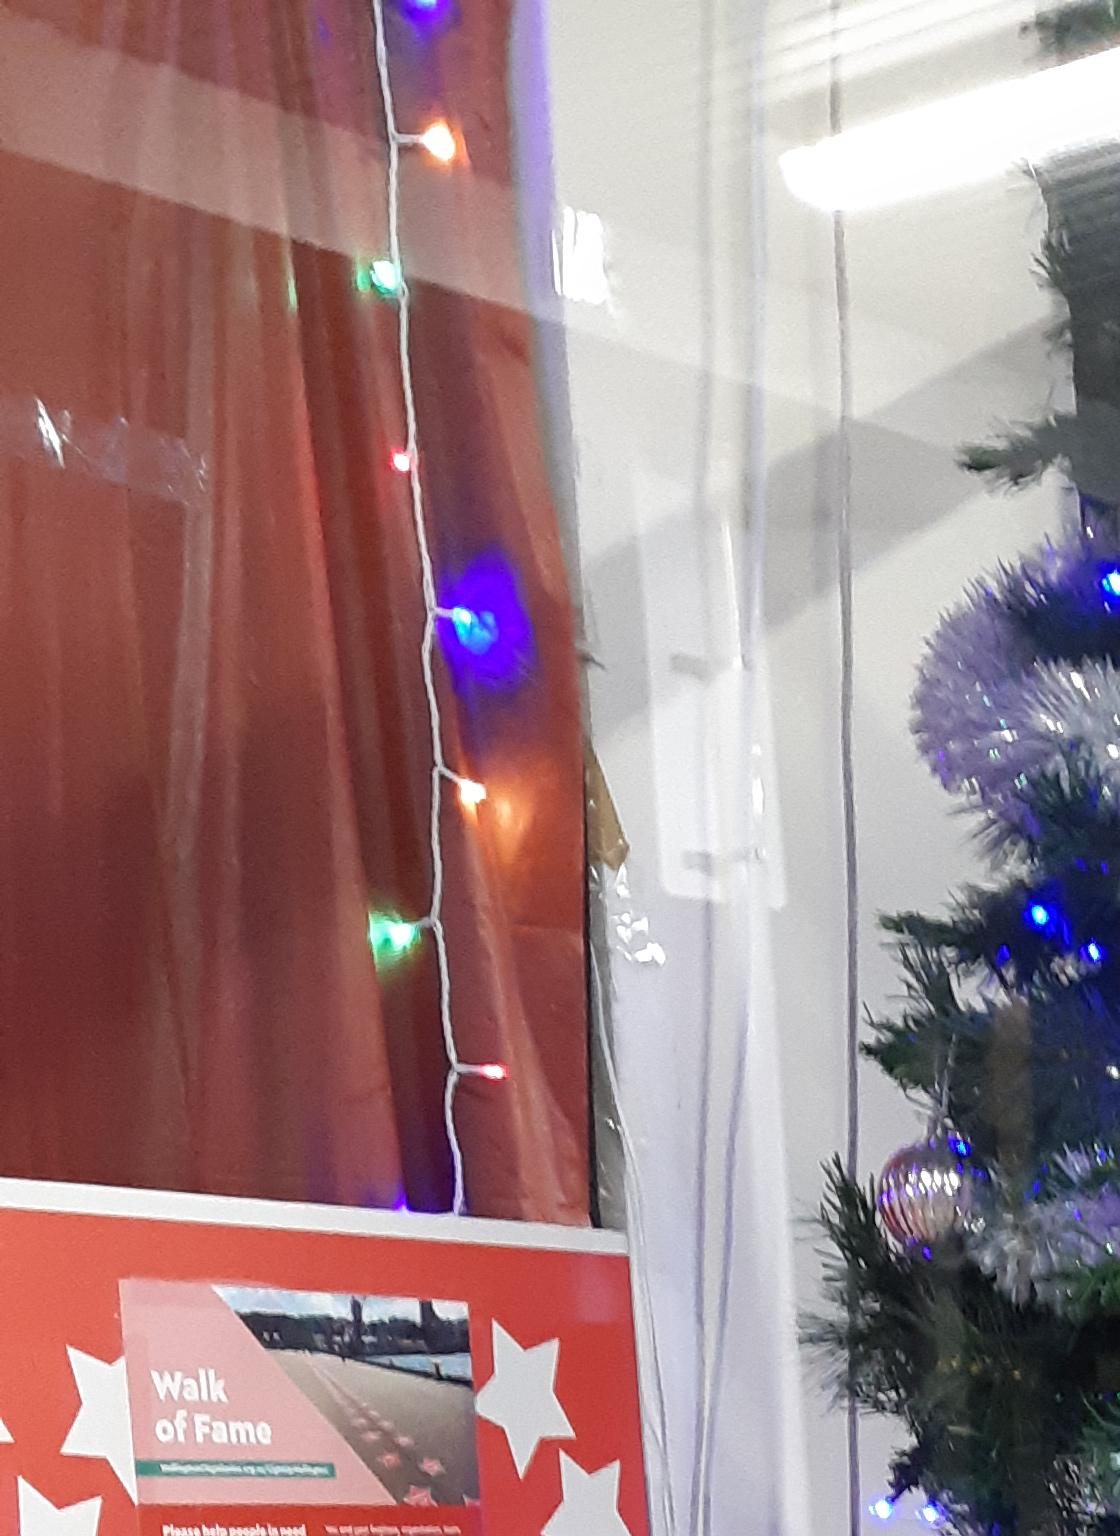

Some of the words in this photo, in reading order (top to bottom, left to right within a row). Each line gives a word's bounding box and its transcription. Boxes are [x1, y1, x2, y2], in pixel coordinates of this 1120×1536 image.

[150, 1368, 229, 1403] Walk
[155, 1408, 188, 1444] of
[193, 1412, 273, 1445] Fame
